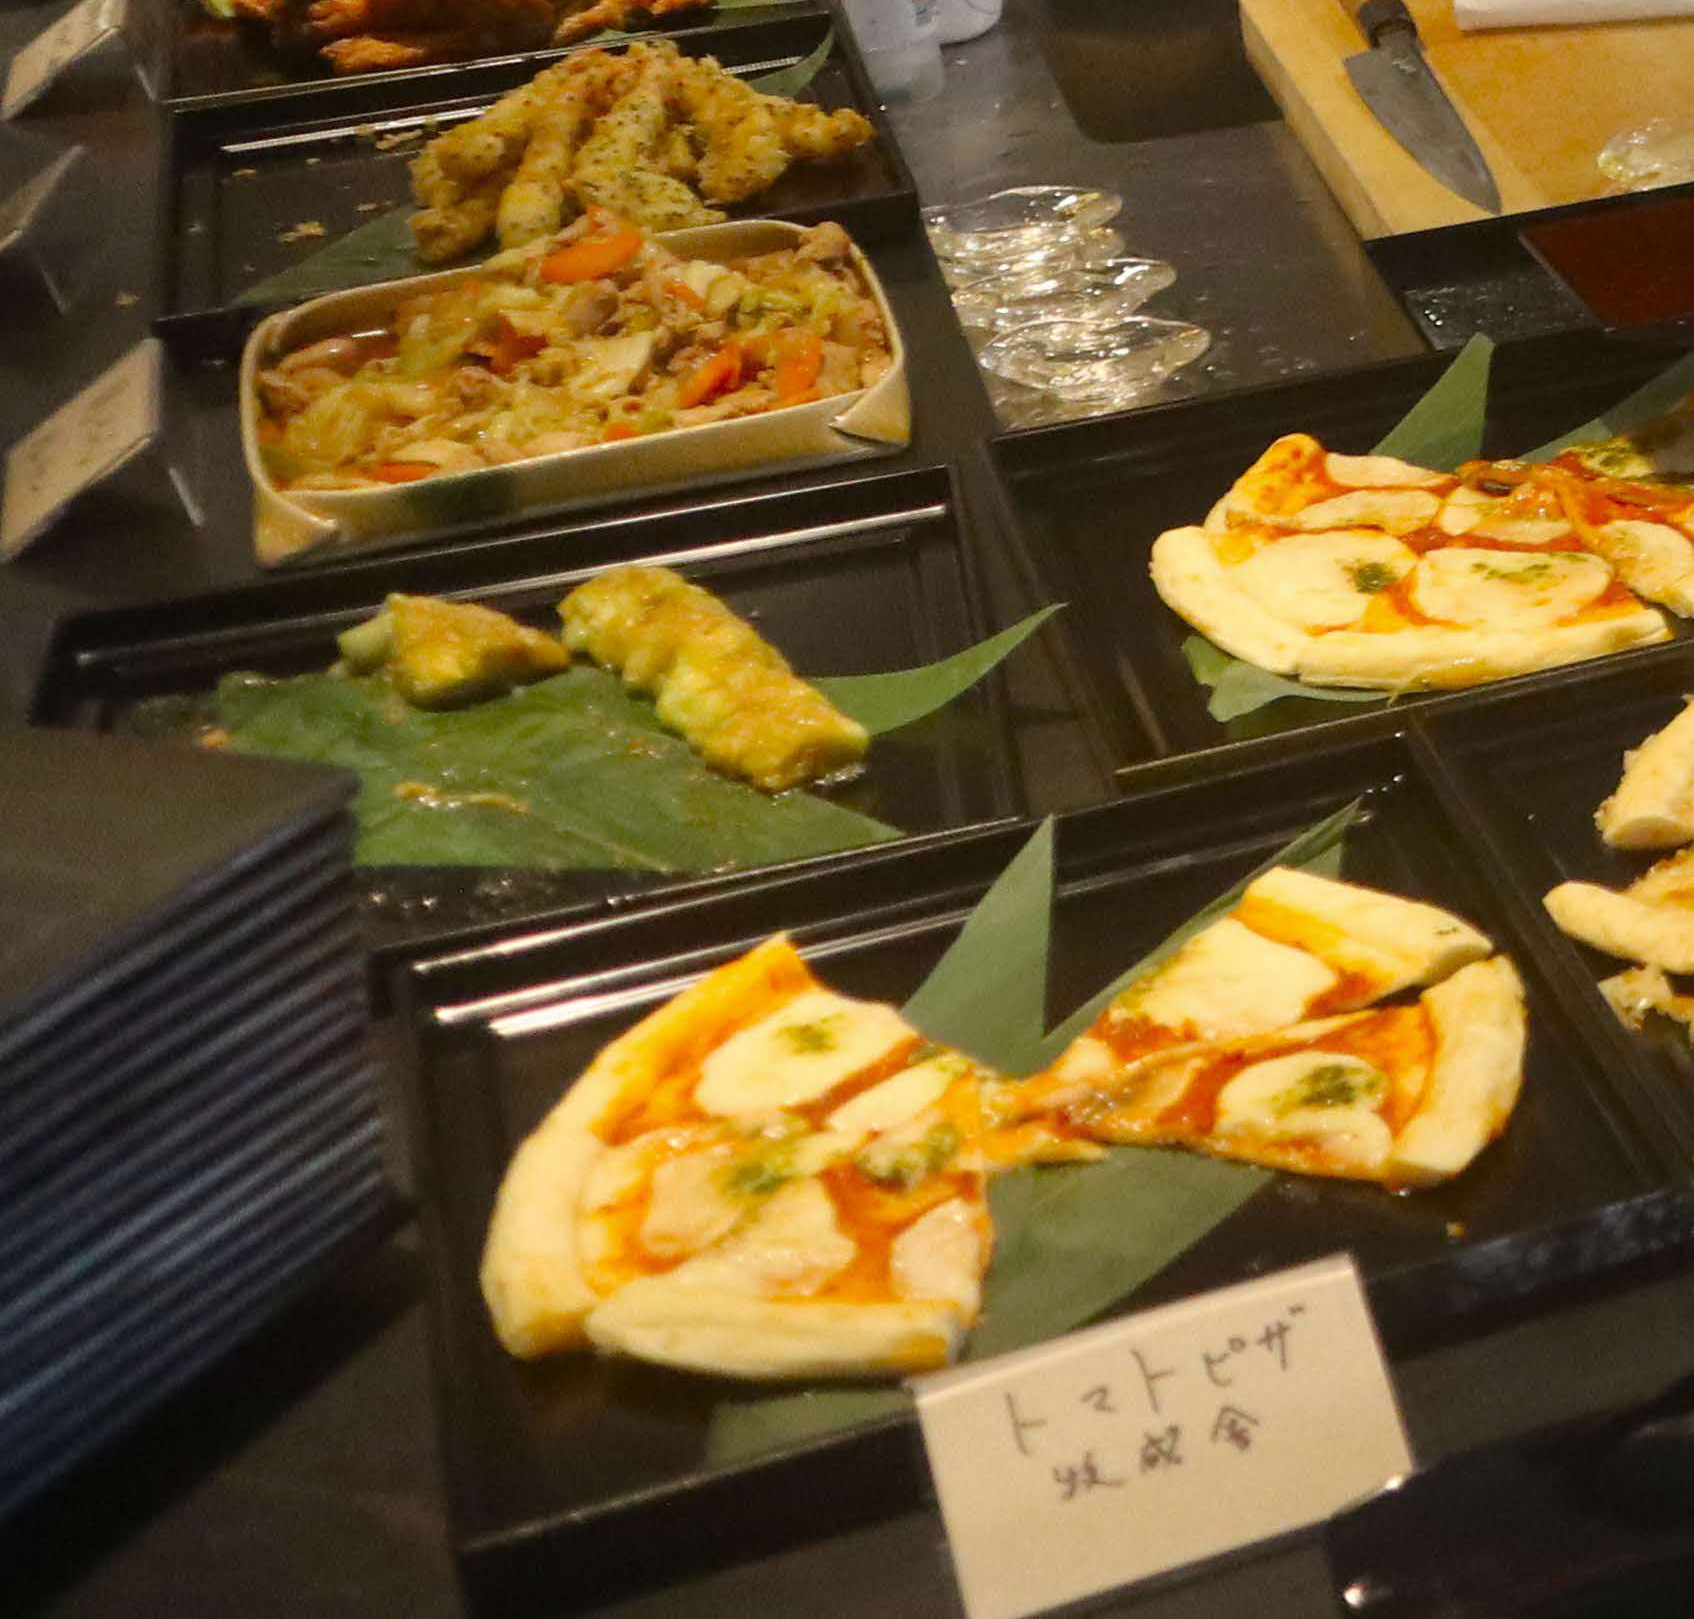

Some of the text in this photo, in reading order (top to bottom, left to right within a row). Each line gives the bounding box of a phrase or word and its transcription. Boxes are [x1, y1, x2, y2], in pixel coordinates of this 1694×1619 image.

[1006, 1304, 1304, 1456] トマトピザ
